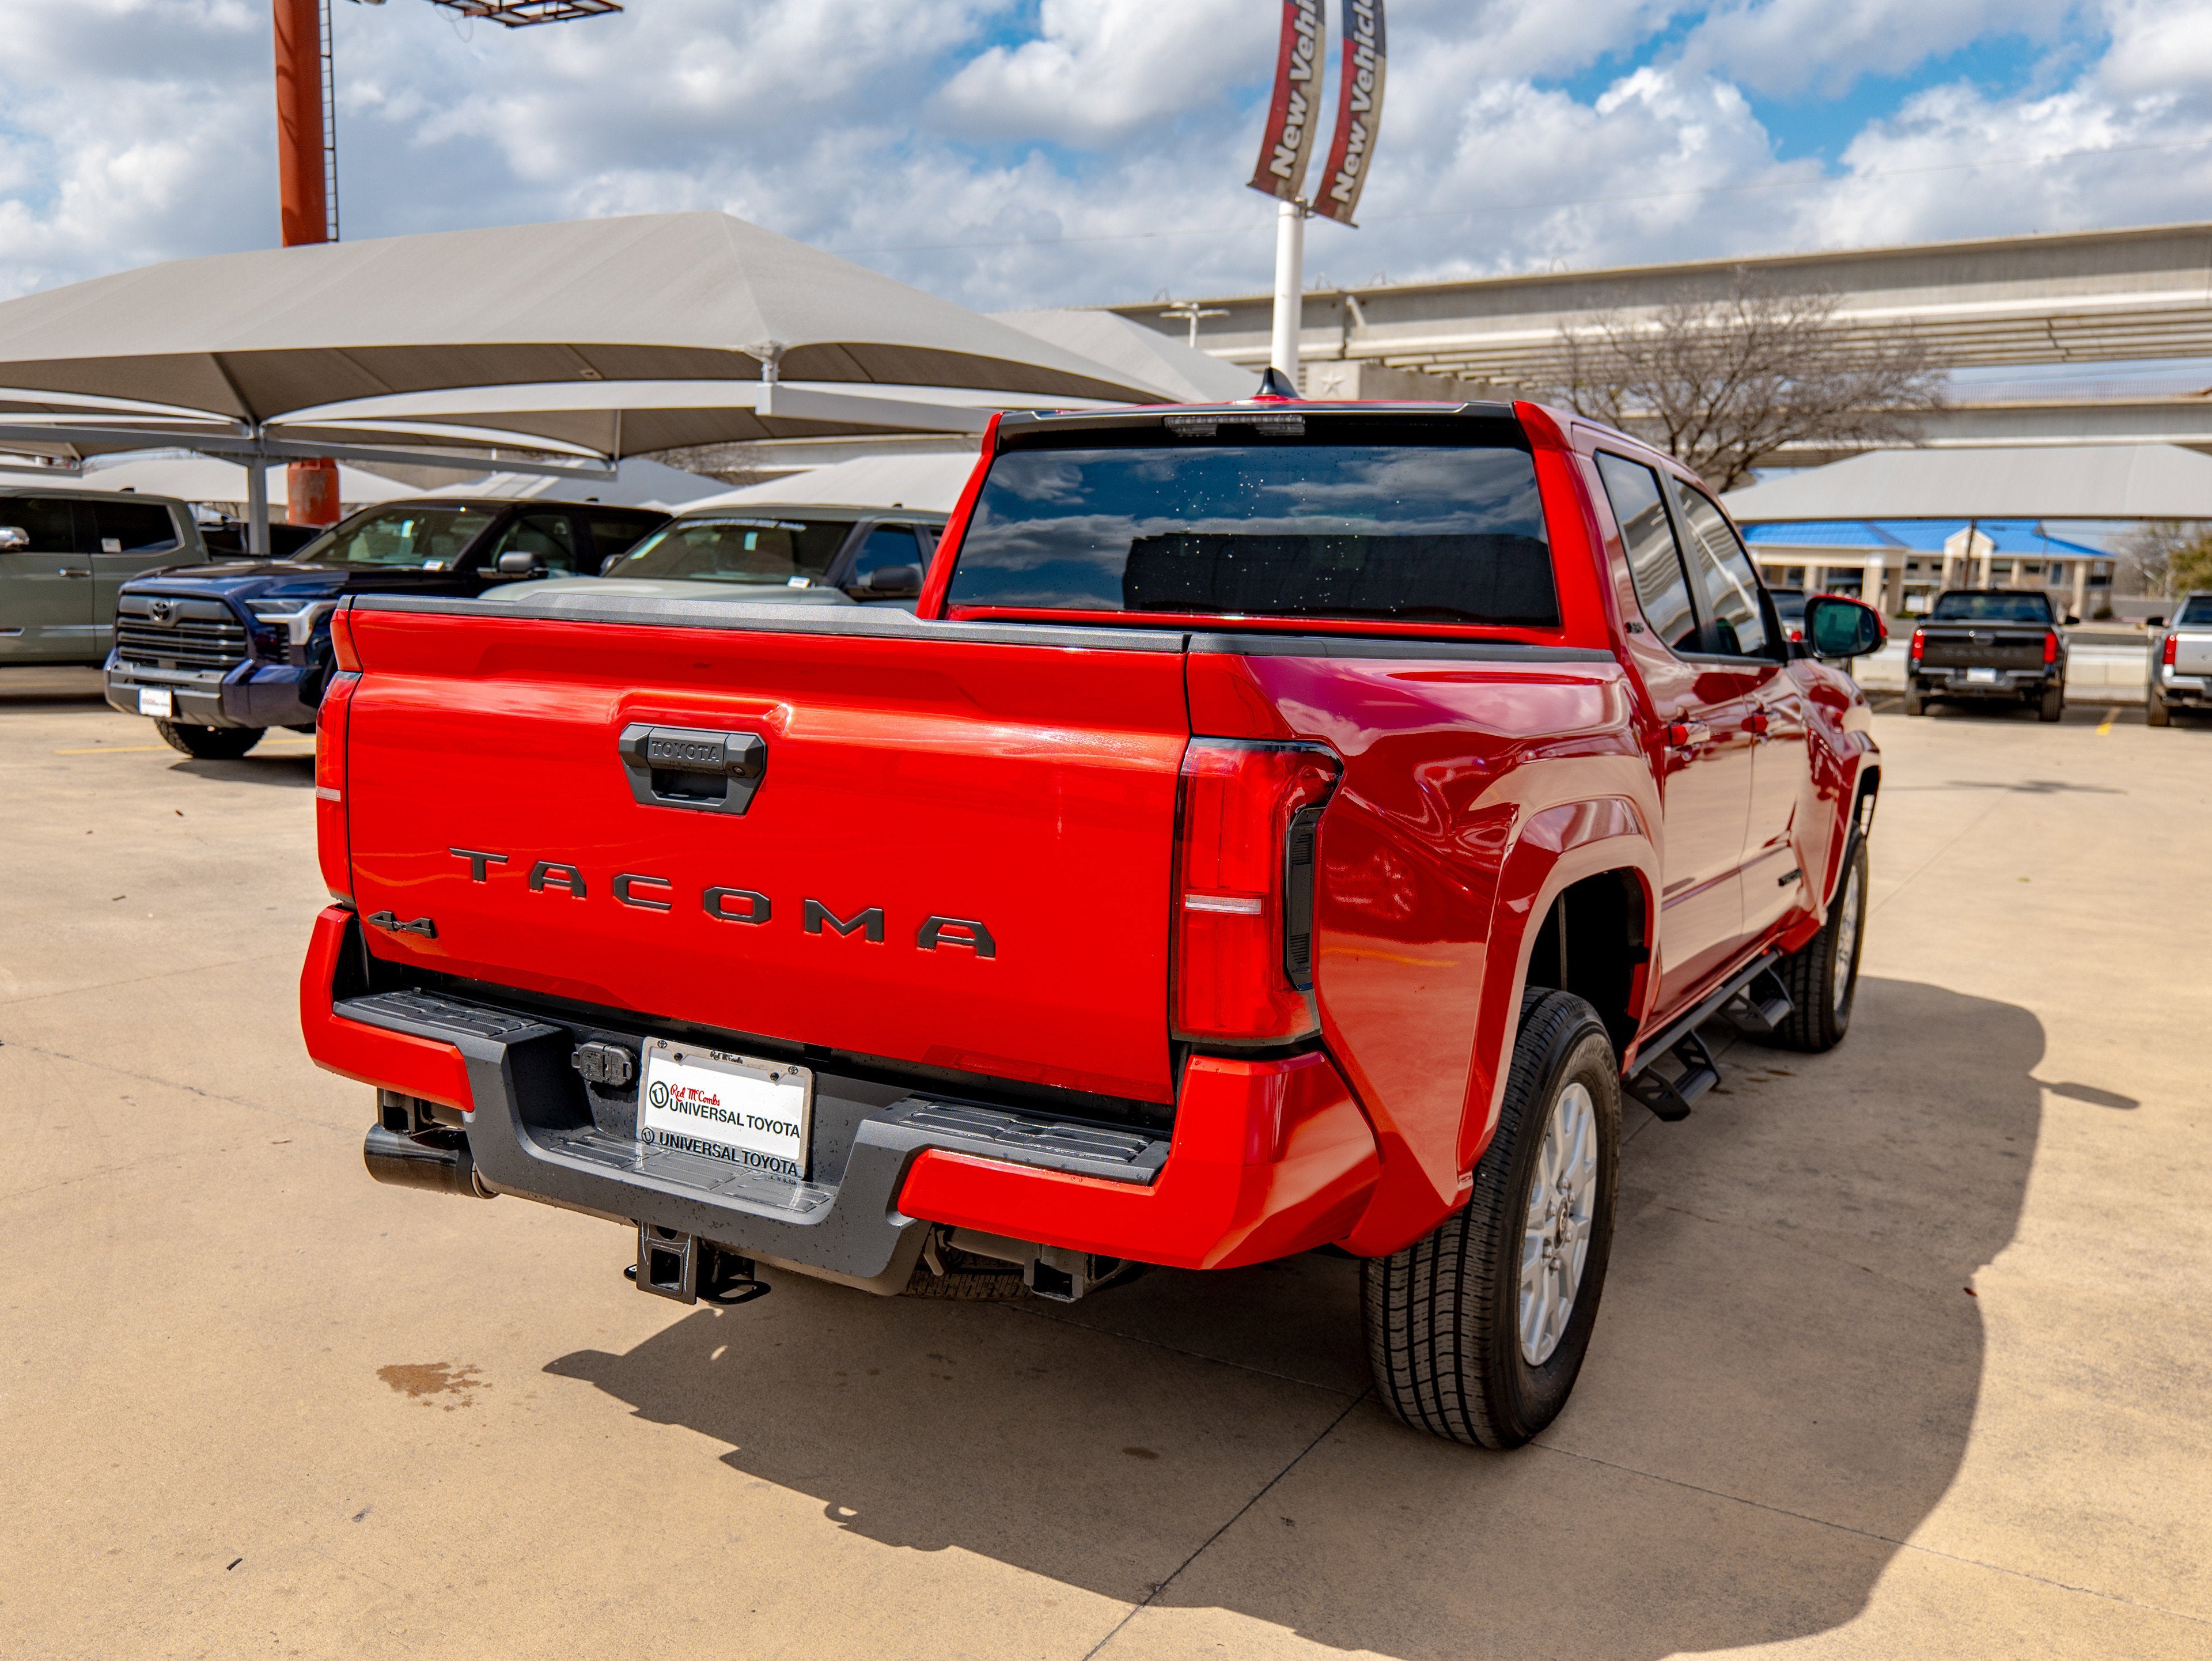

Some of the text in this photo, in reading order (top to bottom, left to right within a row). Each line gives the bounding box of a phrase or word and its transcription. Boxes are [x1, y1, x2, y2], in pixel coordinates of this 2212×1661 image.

[1269, 0, 1317, 179] New Vehi
[1330, 120, 1368, 203] New
[652, 741, 719, 762] TOYOTA
[449, 847, 996, 958] TACOMA
[670, 1084, 719, 1106] Red McCombs
[670, 1098, 800, 1138] UNIVERSAL TOYOTA
[660, 1131, 798, 1176] UNIVERSAL TOYOTA
